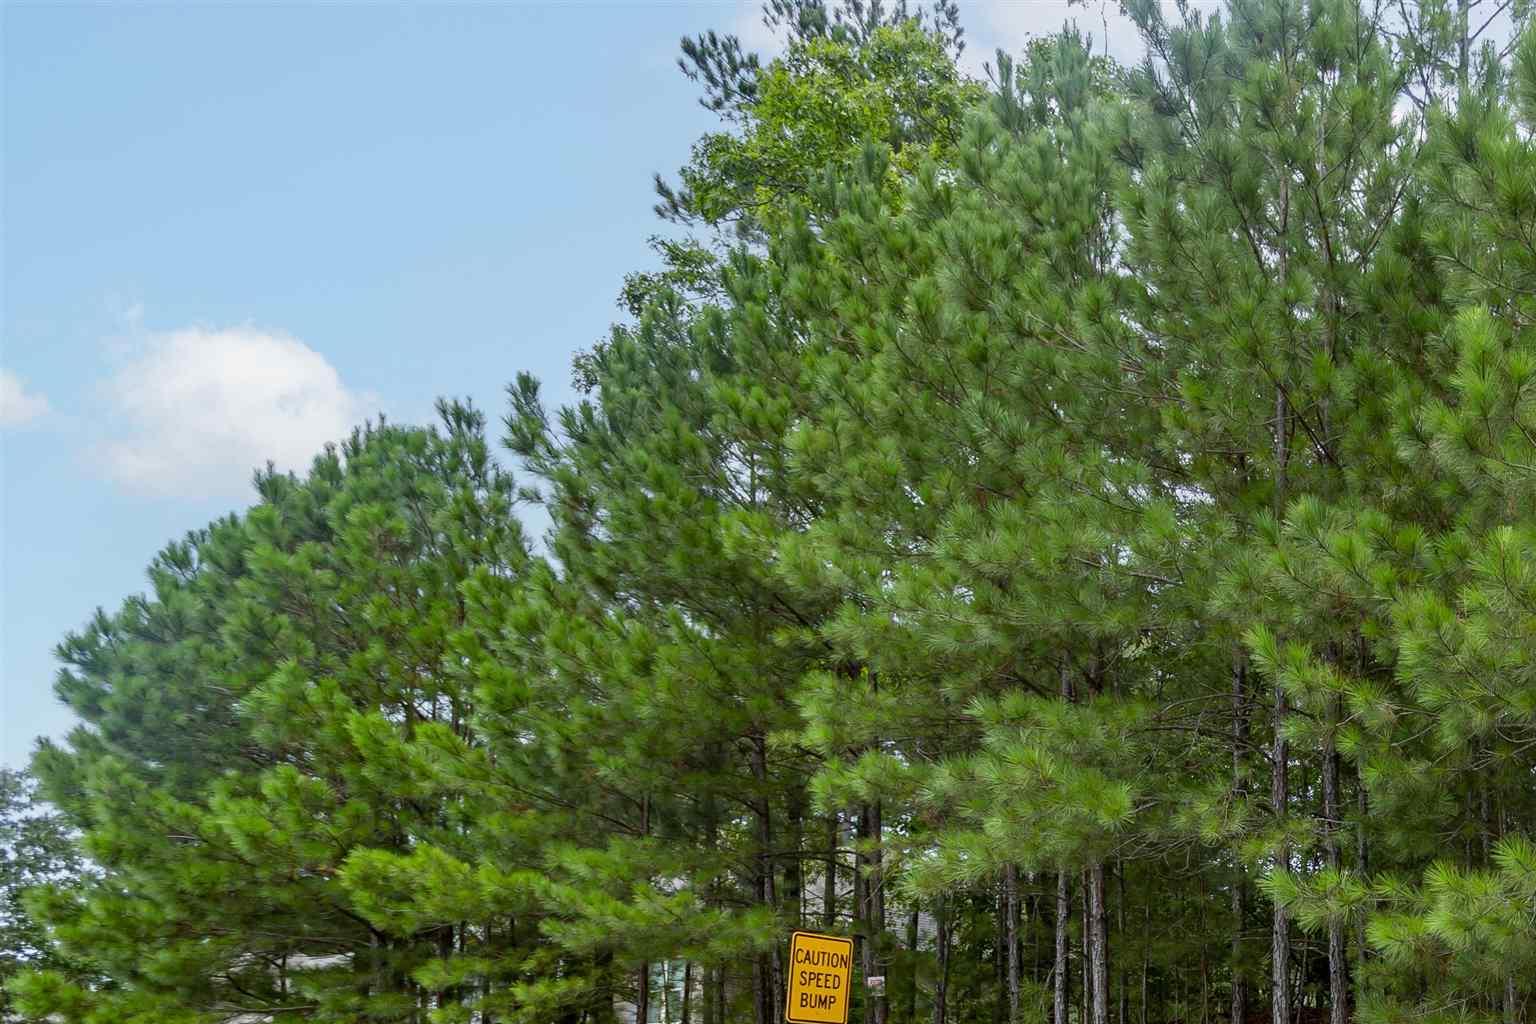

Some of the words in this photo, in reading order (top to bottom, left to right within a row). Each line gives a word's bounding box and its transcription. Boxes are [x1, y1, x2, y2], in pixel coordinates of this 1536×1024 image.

[795, 948, 848, 968] CAUTION
[800, 971, 840, 989] SPEED
[800, 993, 836, 1010] BUMP
